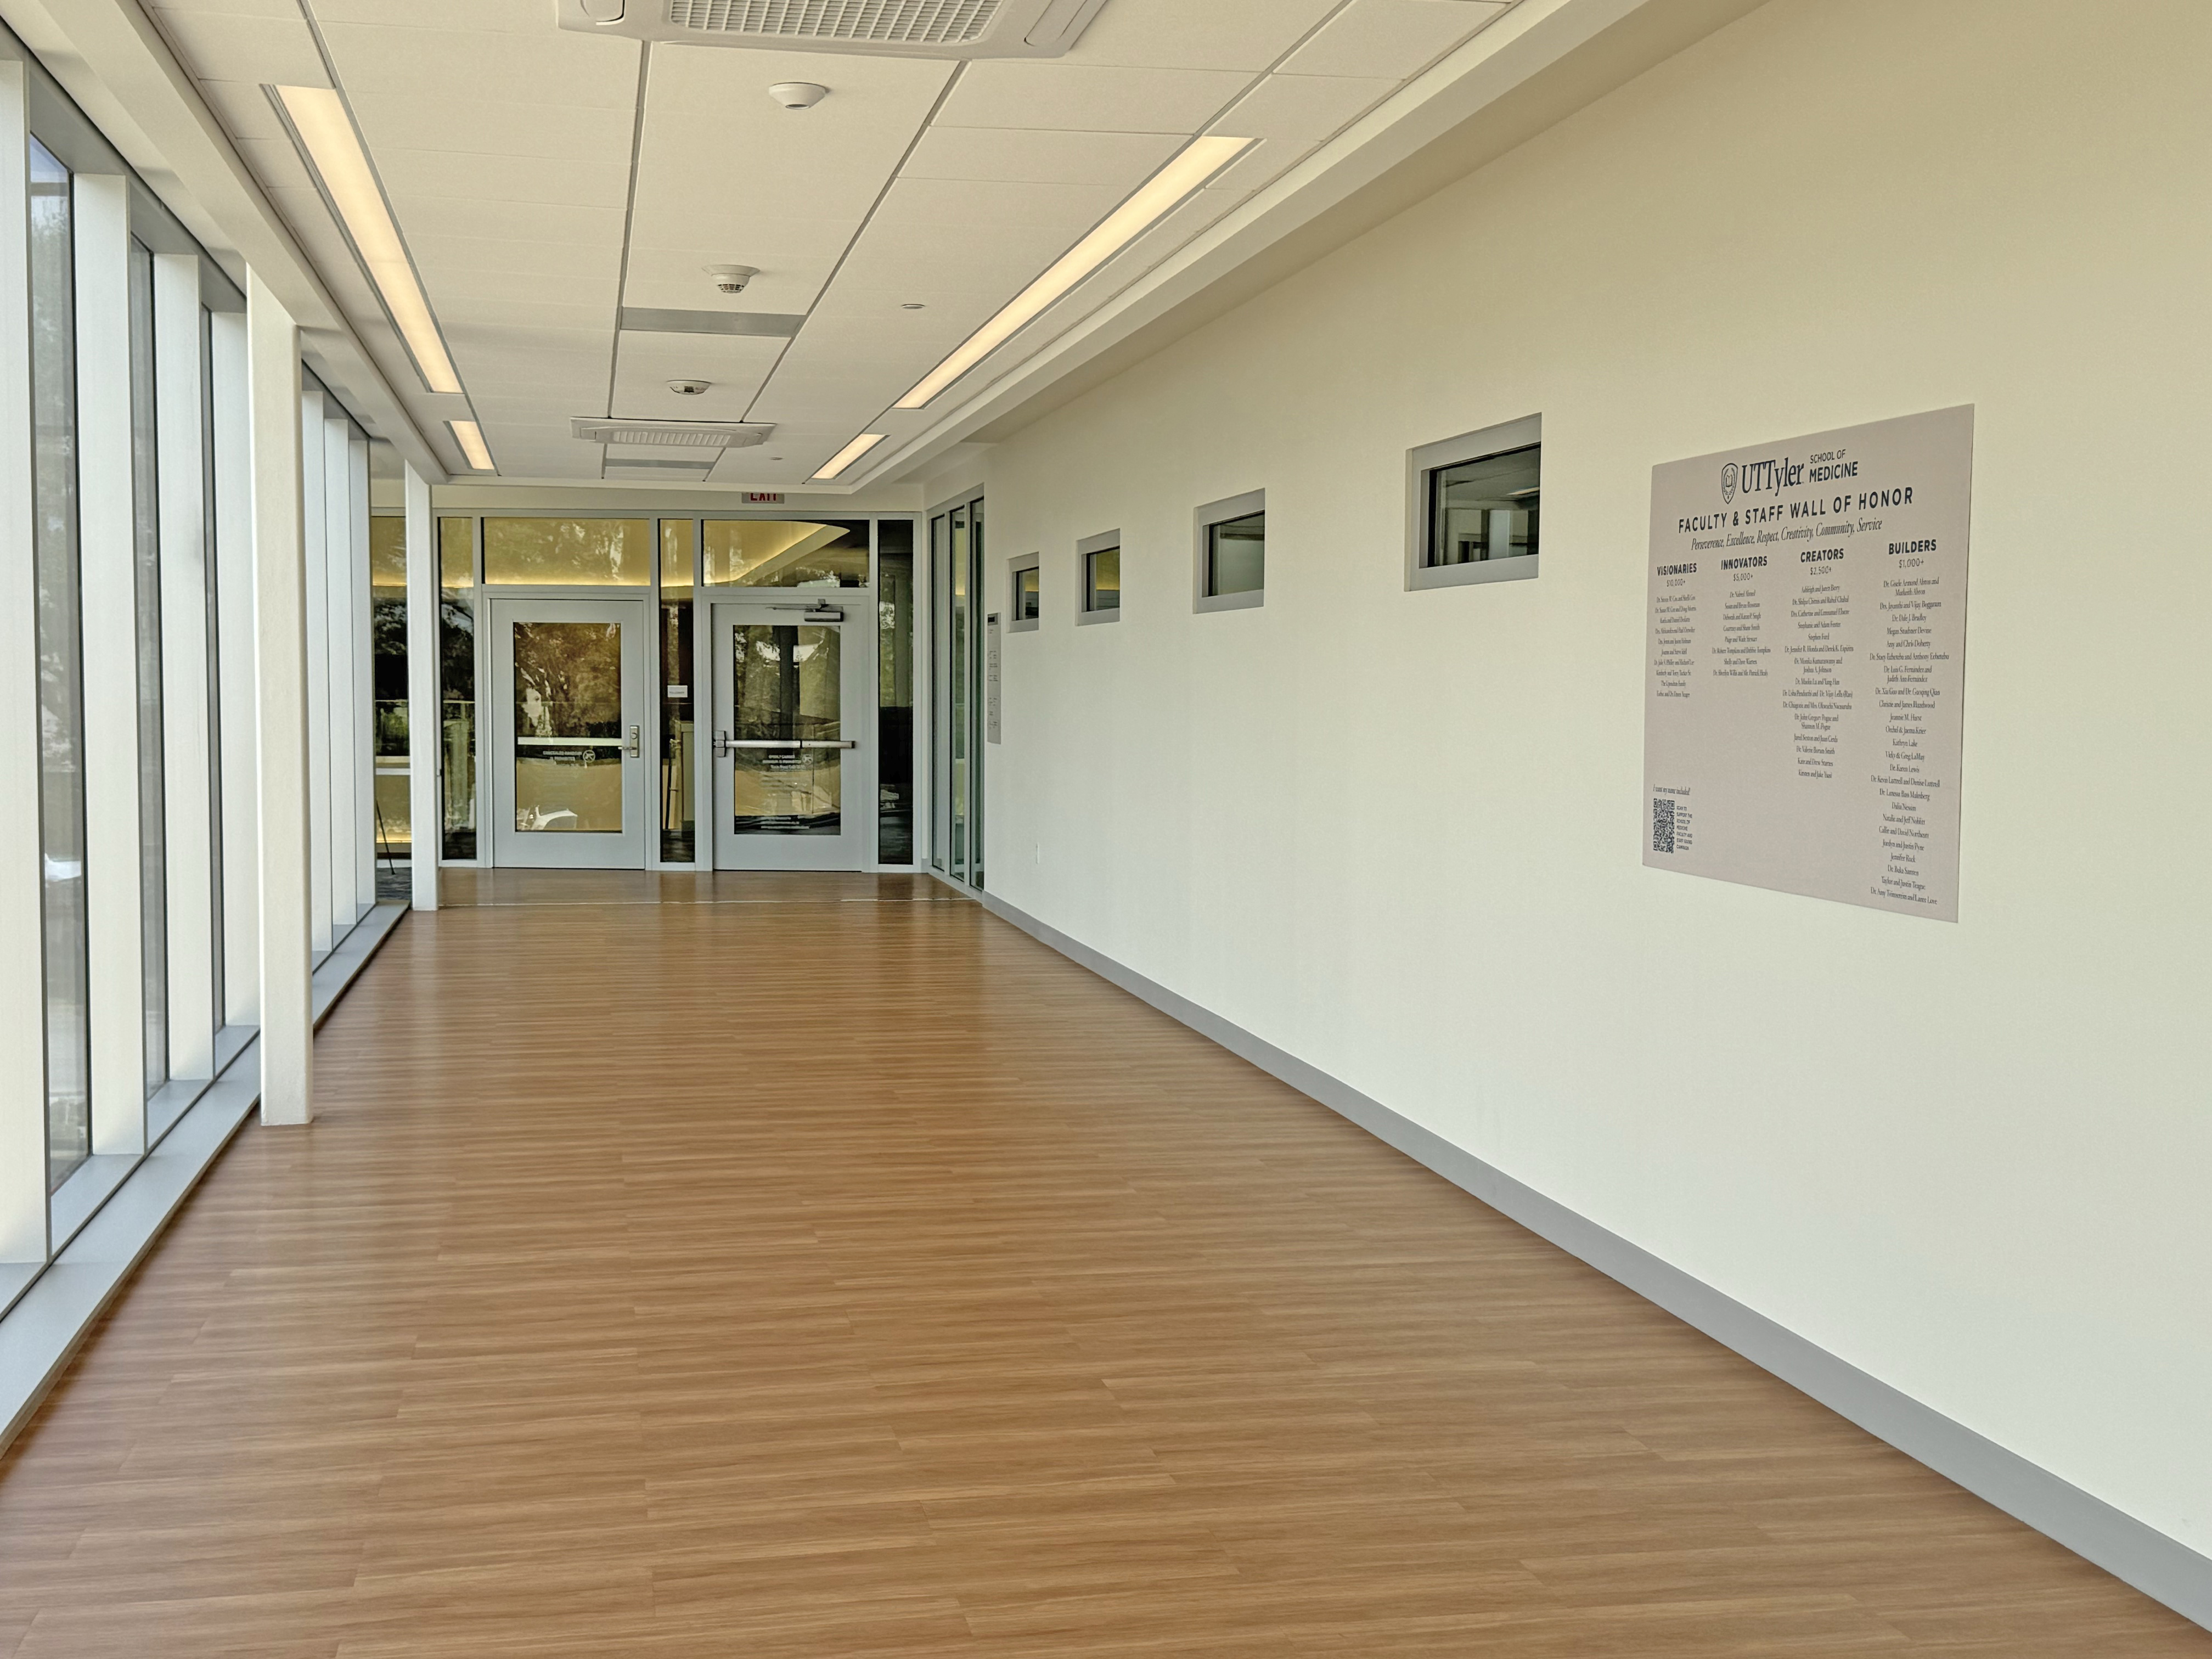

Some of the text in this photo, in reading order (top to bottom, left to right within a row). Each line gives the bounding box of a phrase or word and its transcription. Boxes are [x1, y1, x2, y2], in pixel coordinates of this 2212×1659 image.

[1810, 449, 1845, 464] SCHOOL OF
[1809, 462, 1858, 483] MEDICINE
[1679, 487, 1912, 533] FACULTY & STAFF WALL OF HONOR
[1757, 530, 1779, 546] Respect,
[1781, 526, 1814, 542] Creativity,
[1816, 521, 1855, 537] Community,
[1856, 518, 1882, 532] Service
[1889, 539, 1936, 555] BUILDERS
[1721, 556, 1767, 570] INNOVATORS
[1800, 548, 1844, 563] CREATORS
[1657, 563, 1697, 576] VISIONARIES
[1899, 558, 1924, 569] $1,000+
